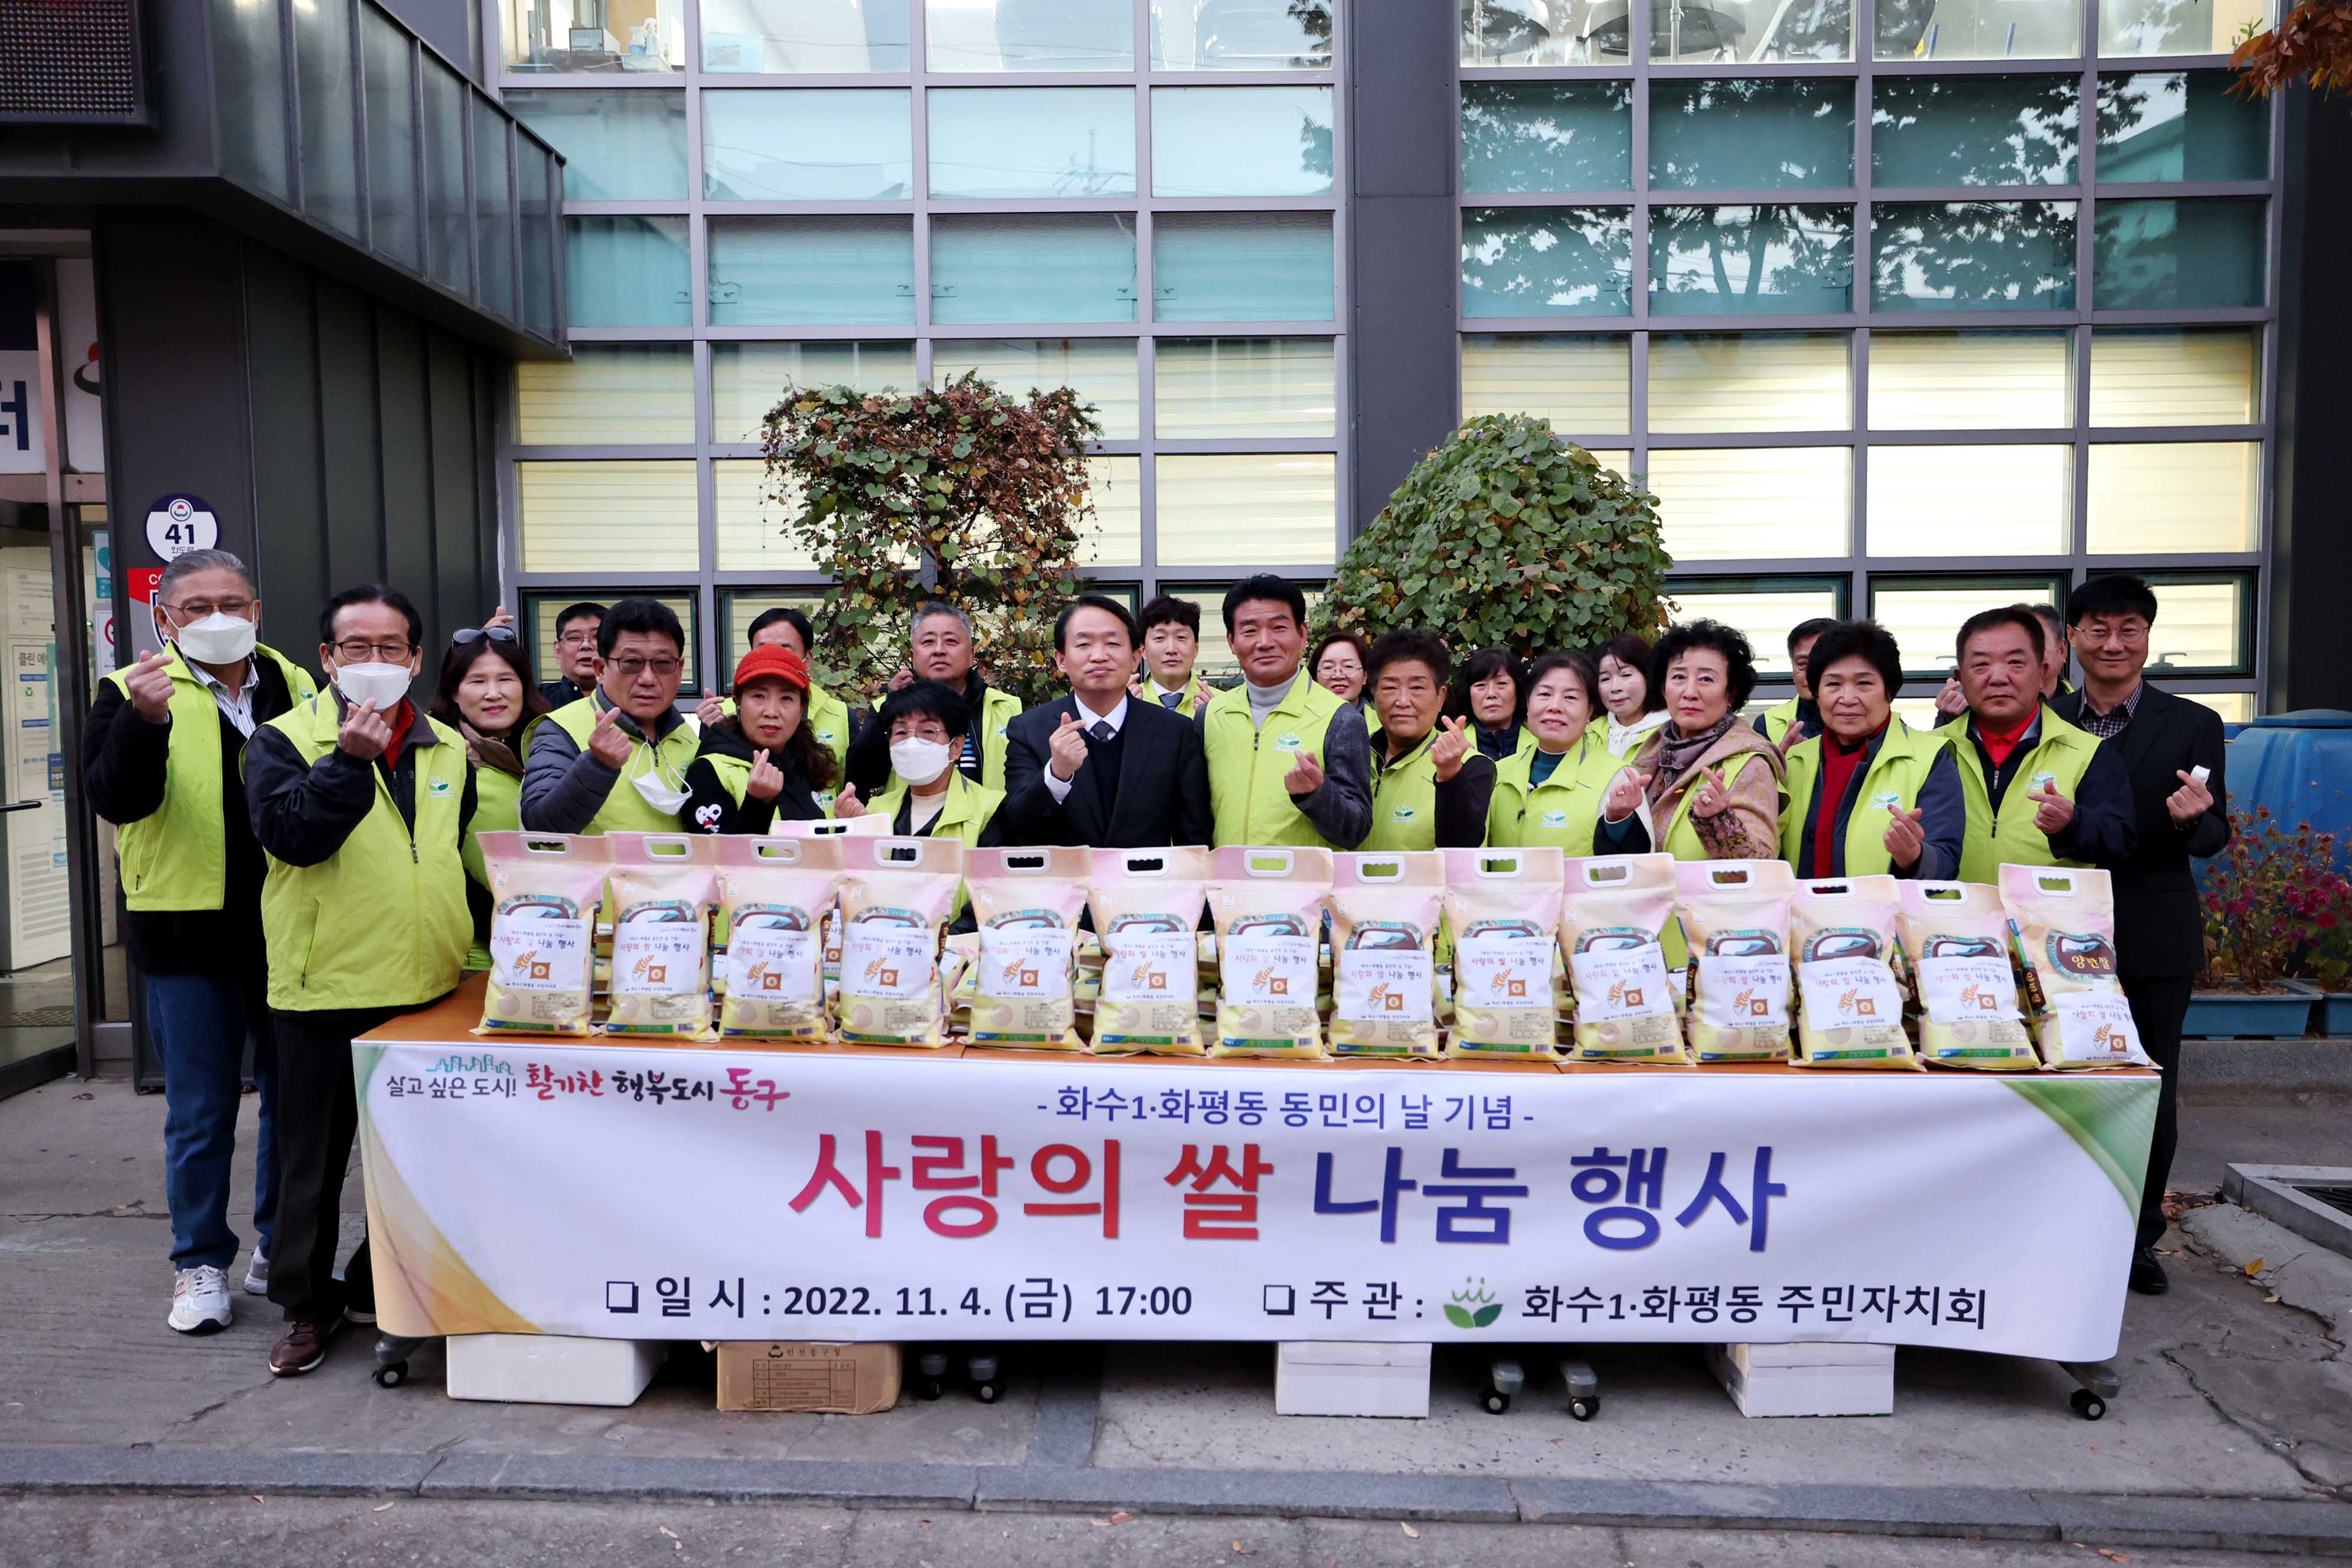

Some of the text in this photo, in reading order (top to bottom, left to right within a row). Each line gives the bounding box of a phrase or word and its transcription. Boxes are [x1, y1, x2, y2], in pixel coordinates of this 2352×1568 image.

[165, 524, 194, 544] 41
[538, 939, 553, 949] 나눔
[558, 939, 575, 949] 행사
[655, 943, 669, 951] 나눔
[674, 943, 690, 952] 행사
[887, 946, 901, 955] 나눔
[906, 946, 922, 956] 행사
[1025, 947, 1040, 955] 나눔
[1044, 946, 1060, 956] 행사
[1170, 950, 1185, 959] 행사
[1274, 955, 1289, 963] 나눔
[1293, 955, 1307, 964] 행사
[1471, 958, 1494, 966] 사랑의
[1529, 958, 1544, 966] 행사
[2071, 955, 2111, 971] 양반쌀
[1643, 963, 1657, 974] 행사
[1389, 970, 1403, 980] 나눔
[1408, 970, 1422, 980] 행사
[1752, 975, 1766, 984] 나눔
[1855, 977, 1870, 985] 나눔
[387, 1063, 791, 1112] 살고 싶은 도시! 활기찬 행복도시 동구
[1279, 1092, 1386, 1129] 동민의
[1401, 1094, 1433, 1130] 날
[1444, 1094, 1513, 1131] 기념
[788, 1129, 1788, 1252] 사랑의 쌀 나눔 행사
[783, 1286, 882, 1317] 2022.
[895, 1287, 948, 1317] 11.
[959, 1288, 992, 1317] 4.
[1005, 1278, 1073, 1322] (금)
[1095, 1286, 1193, 1316] 17:00
[1776, 1284, 1986, 1329] 주민자치회
